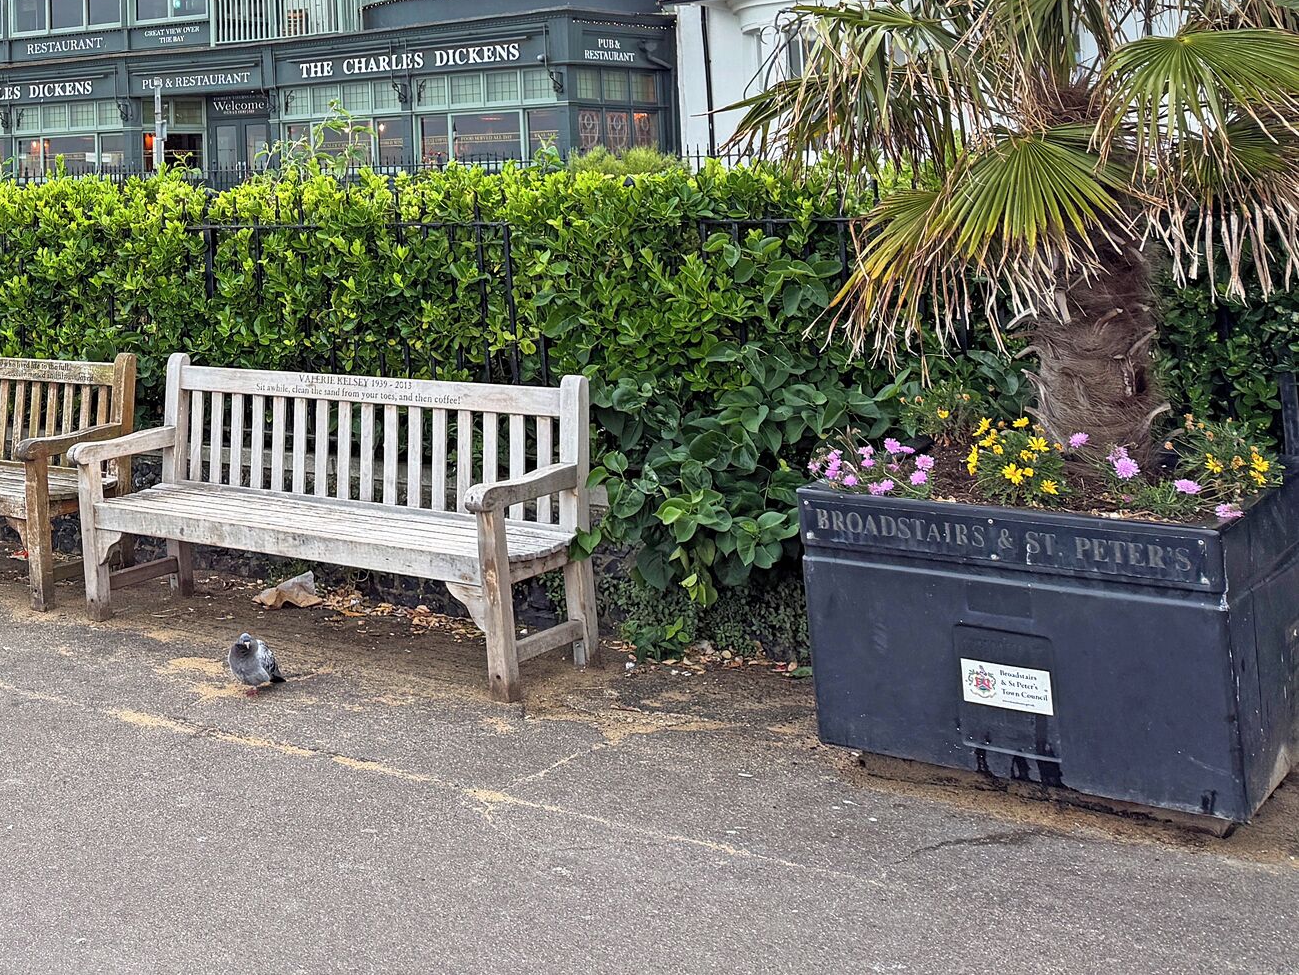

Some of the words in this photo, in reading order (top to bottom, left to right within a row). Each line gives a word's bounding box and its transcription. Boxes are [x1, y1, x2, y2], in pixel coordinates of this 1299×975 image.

[27, 37, 103, 55] RESTAURANT
[300, 62, 333, 78] THE
[343, 52, 423, 74] CHARLES
[435, 43, 520, 67] DICKENS
[585, 50, 635, 62] RESTAURANT
[165, 80, 173, 88] &
[175, 72, 250, 87] RESTAURANT
[29, 81, 93, 98] DICKENS
[213, 100, 265, 111] Welcome
[299, 375, 335, 384] VALERIE
[337, 376, 369, 386] KELSEY
[395, 381, 412, 390] 2013
[267, 384, 290, 394] awhile,
[292, 385, 309, 394] clean
[311, 387, 322, 395] the
[324, 388, 340, 396] sand
[342, 388, 359, 398] from
[361, 392, 378, 400] your
[381, 392, 398, 401] toes,
[399, 393, 413, 401] and
[415, 394, 432, 402] then
[434, 395, 461, 404] coffee!
[815, 508, 985, 548] BROADSTAIRS
[997, 528, 1014, 549] &
[1025, 530, 1063, 557] ST.
[1075, 536, 1192, 572] PETER'S
[999, 670, 1037, 681] Broadstairs
[1016, 682, 1038, 690] Peter's
[1002, 689, 1020, 697] Town
[1021, 692, 1048, 701] Council
